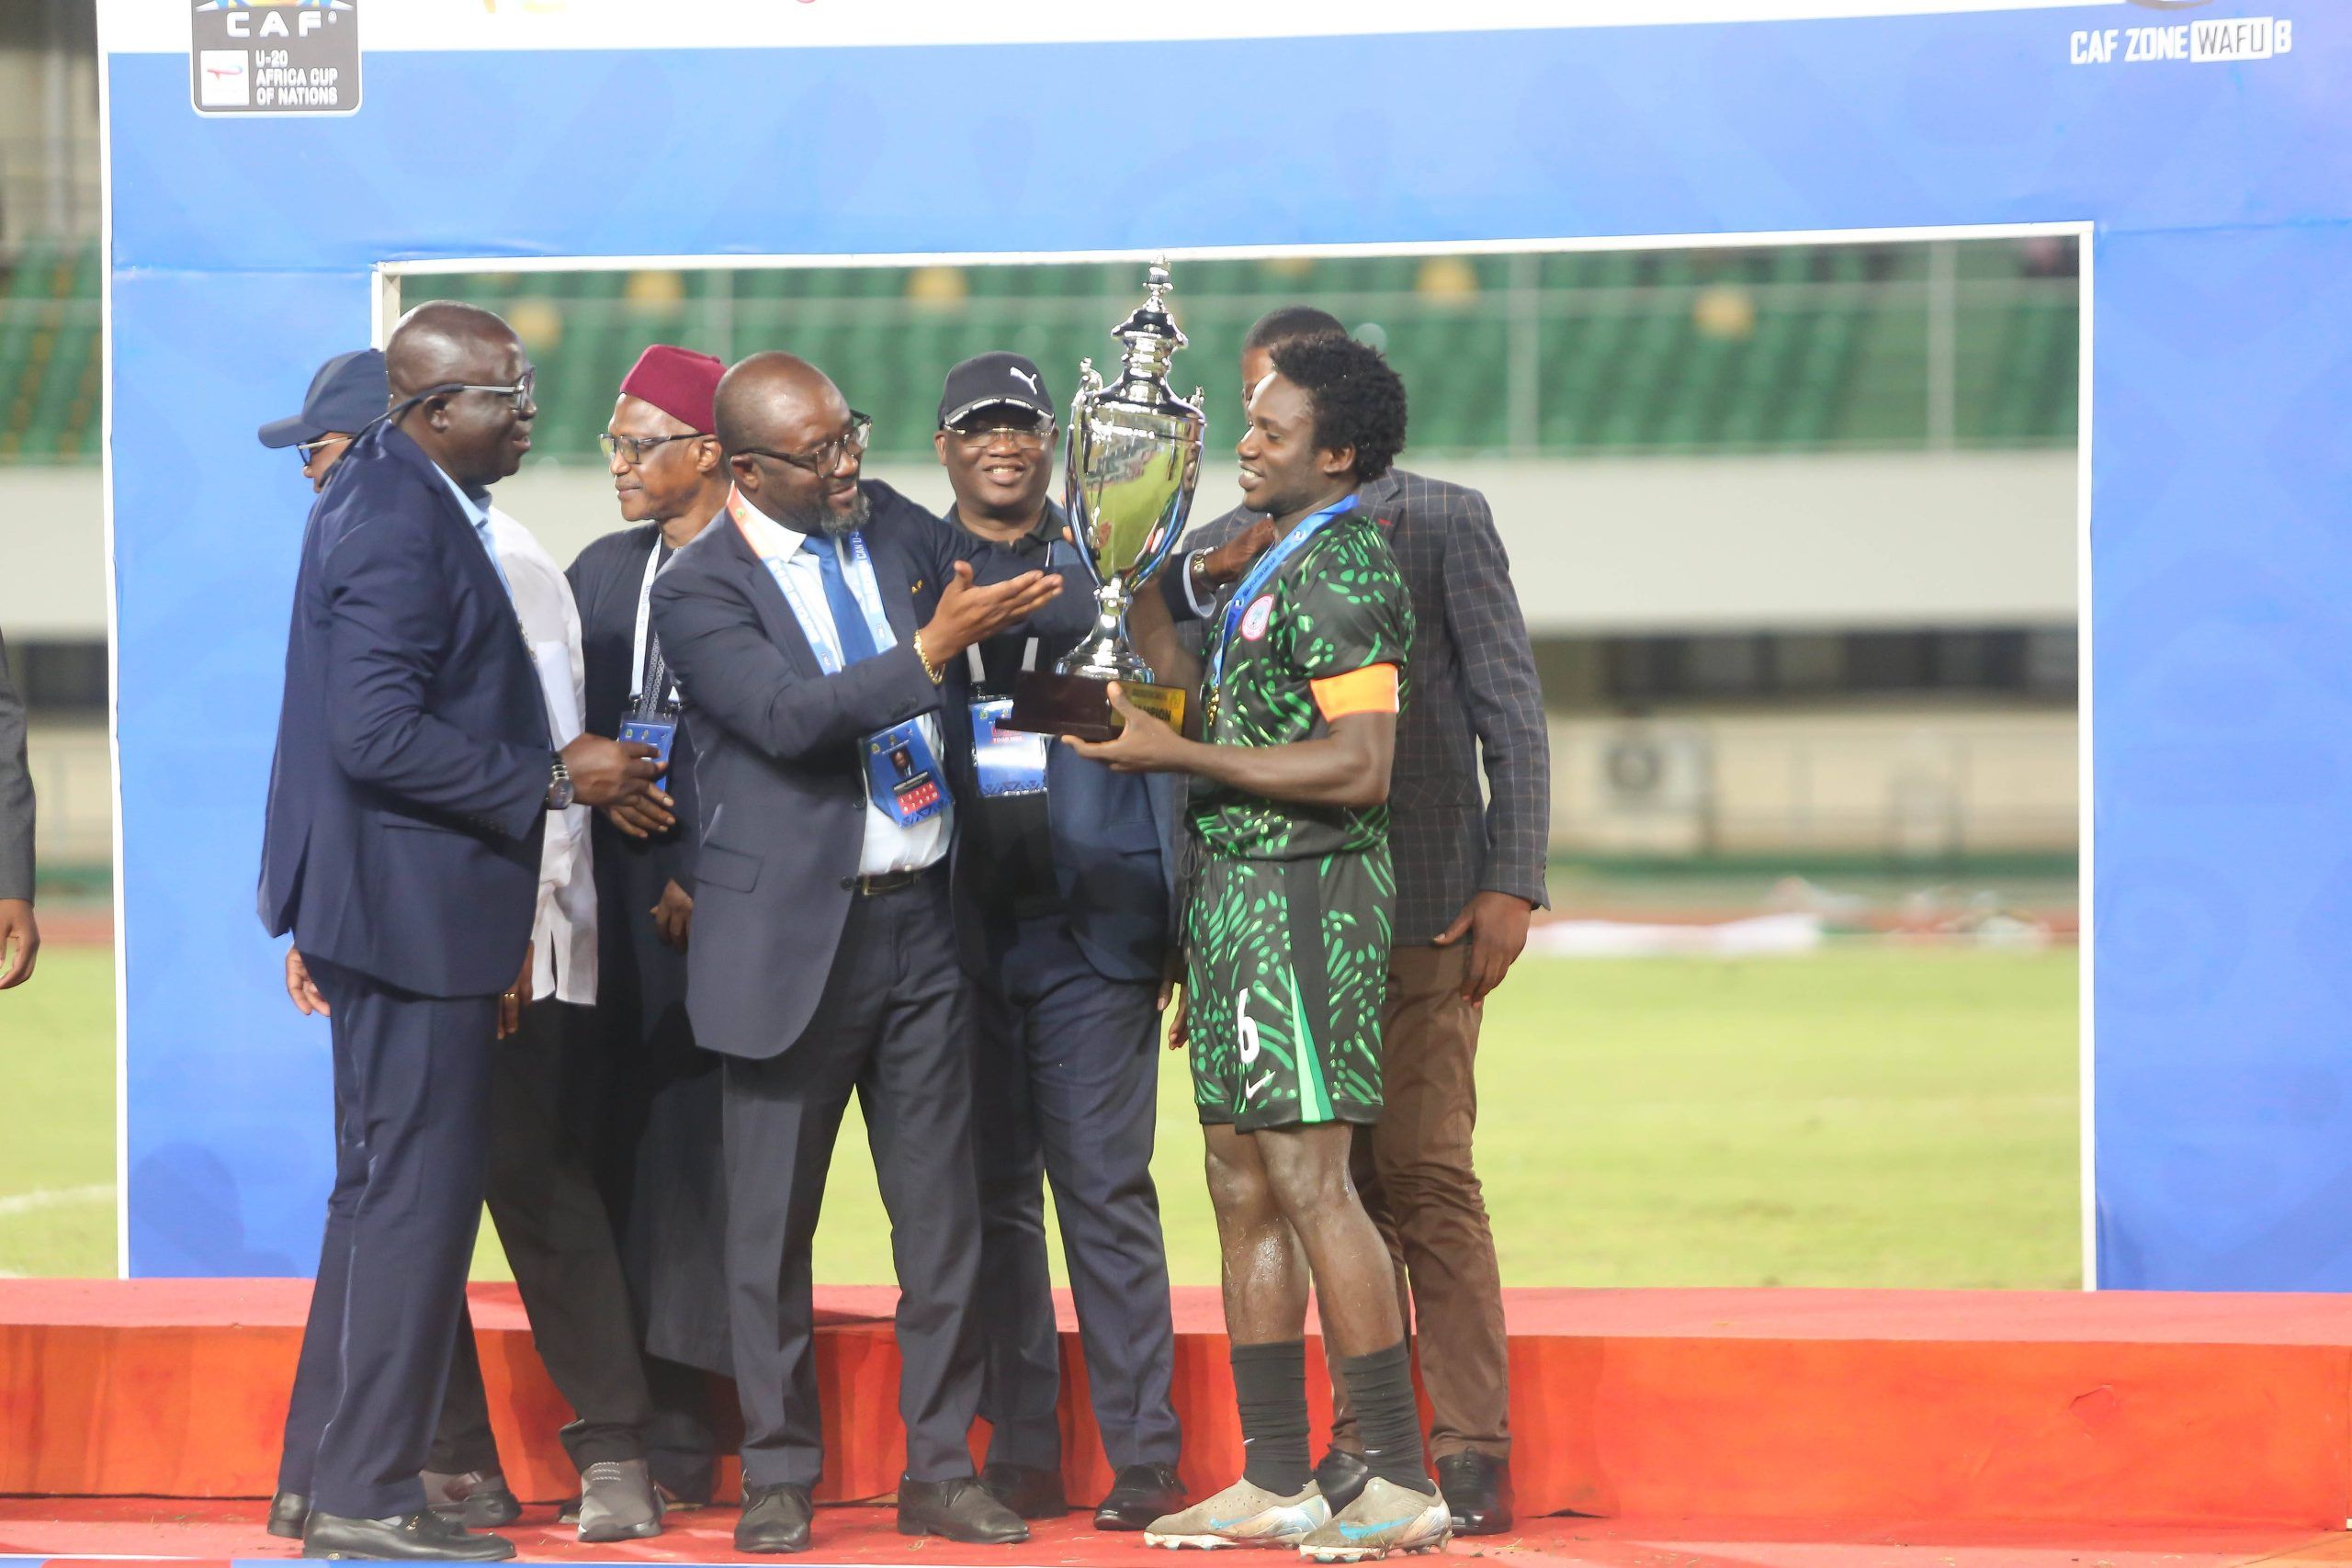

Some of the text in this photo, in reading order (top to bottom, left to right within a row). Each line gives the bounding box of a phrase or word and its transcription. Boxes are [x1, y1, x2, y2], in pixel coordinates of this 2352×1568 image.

[226, 10, 322, 38] CAF
[2070, 19, 2292, 64] CAF ZONE WAFU B
[255, 50, 288, 67] U-20
[255, 67, 338, 87] AFRICA CUP
[256, 86, 338, 106] OF NATIONS
[1238, 987, 1260, 1064] 6
